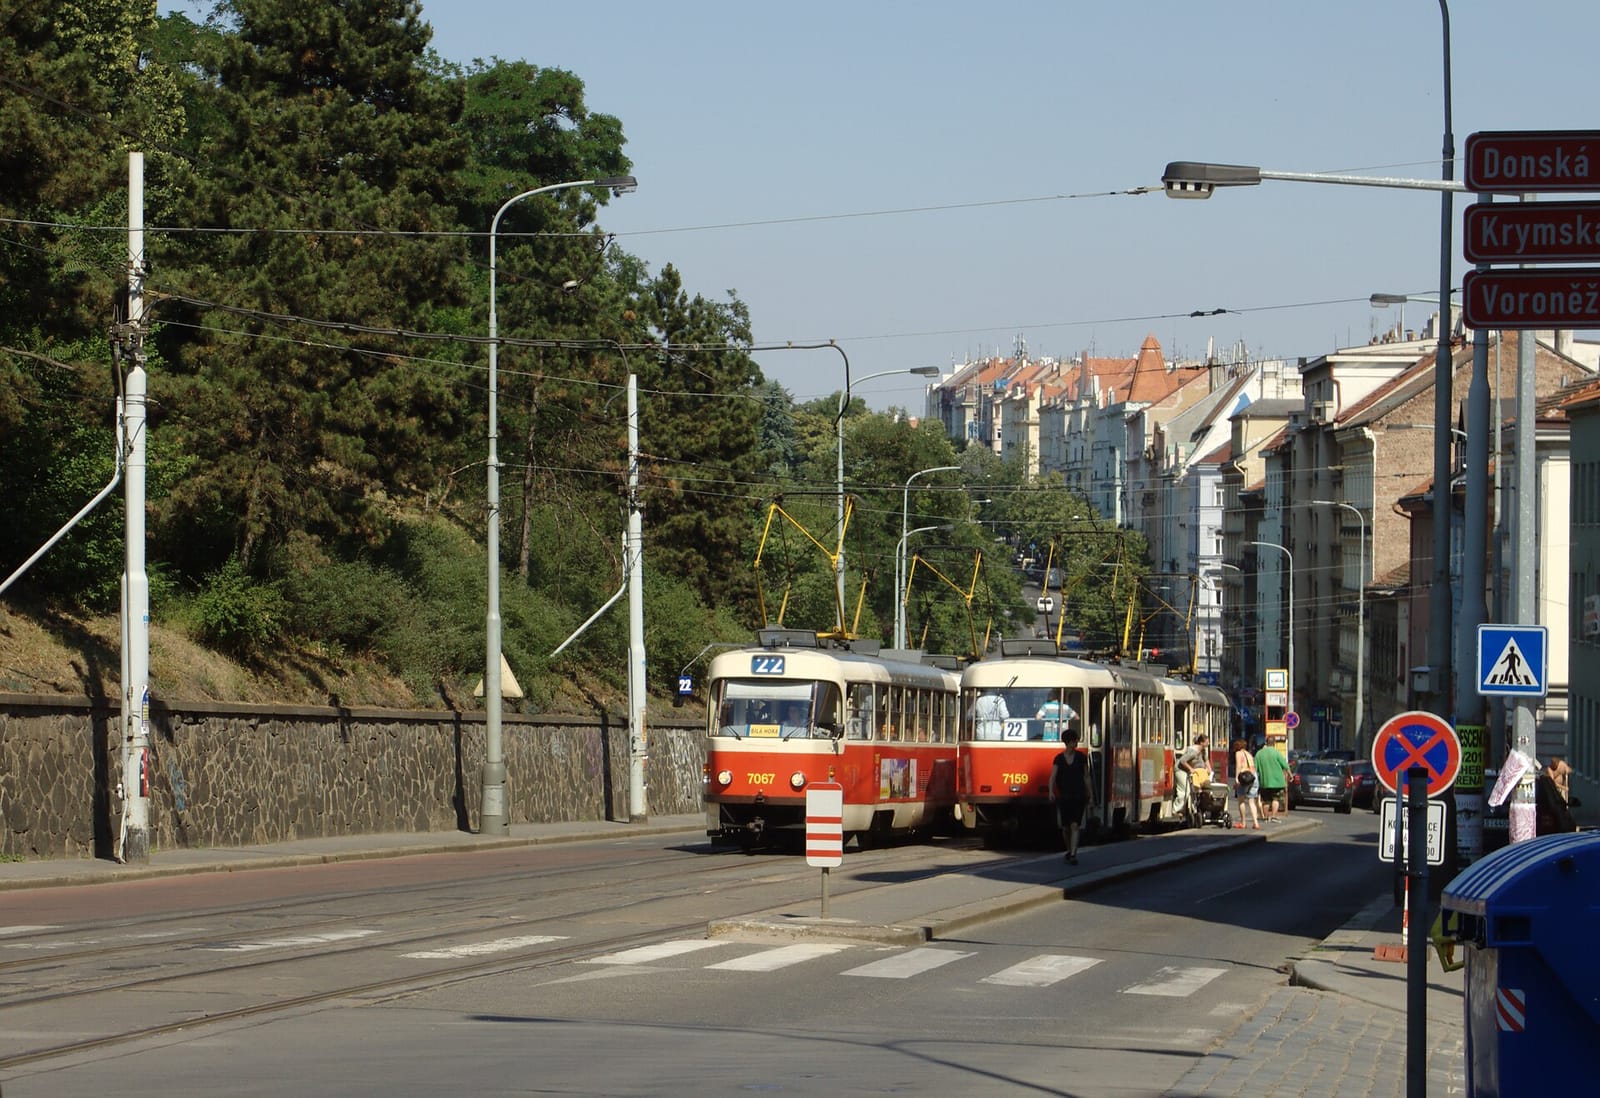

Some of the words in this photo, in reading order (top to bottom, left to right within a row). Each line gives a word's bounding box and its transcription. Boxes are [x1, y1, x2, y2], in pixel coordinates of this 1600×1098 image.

[1483, 145, 1589, 179] Donská
[1481, 282, 1599, 316] Voroněž
[755, 658, 783, 673] 22
[679, 679, 692, 691] 22
[1007, 722, 1022, 737] 22
[747, 773, 776, 785] 7067
[1002, 773, 1029, 785] 7159
